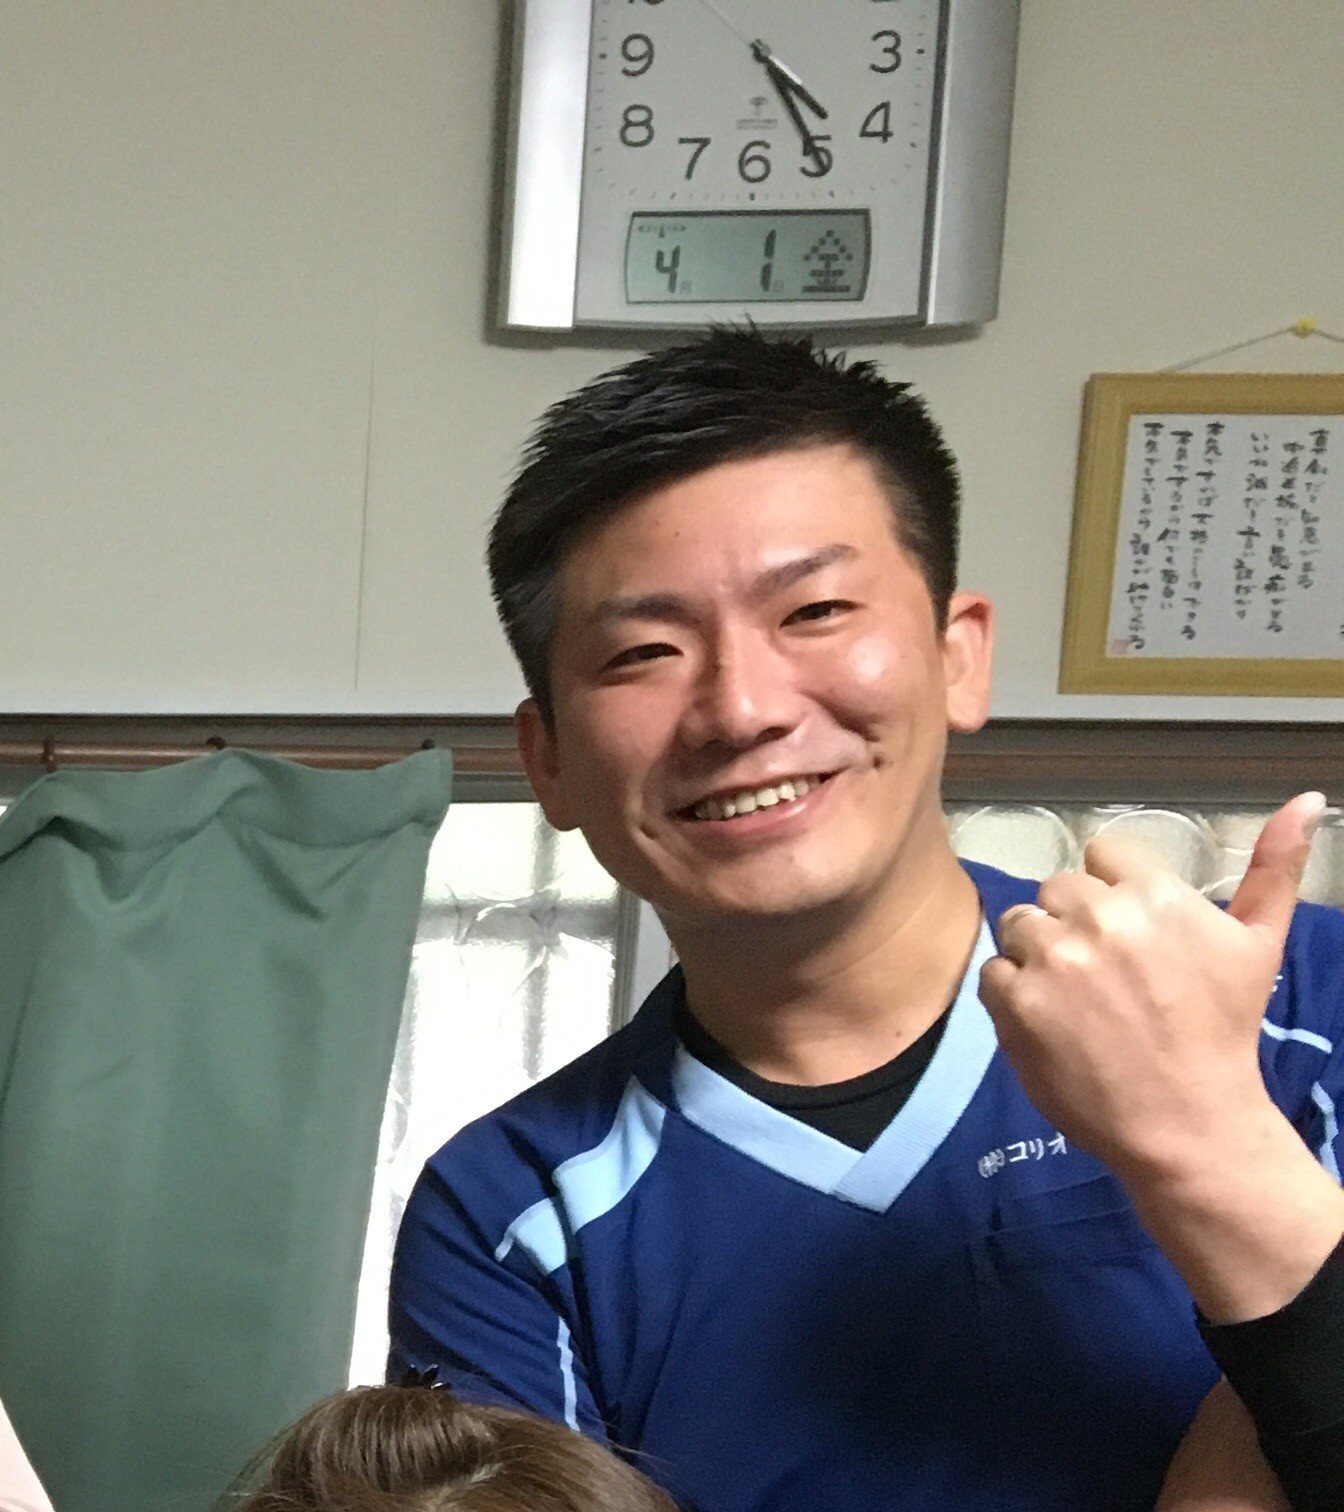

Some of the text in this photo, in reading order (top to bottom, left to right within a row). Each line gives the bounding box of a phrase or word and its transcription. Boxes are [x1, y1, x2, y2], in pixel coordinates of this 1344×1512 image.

[620, 33, 655, 77] 9
[869, 29, 903, 74] 3
[619, 104, 655, 148] 8
[858, 100, 894, 144] 4
[677, 136, 712, 181] 7
[737, 139, 772, 184] 6
[799, 134, 834, 179] 5
[802, 228, 854, 293] 金
